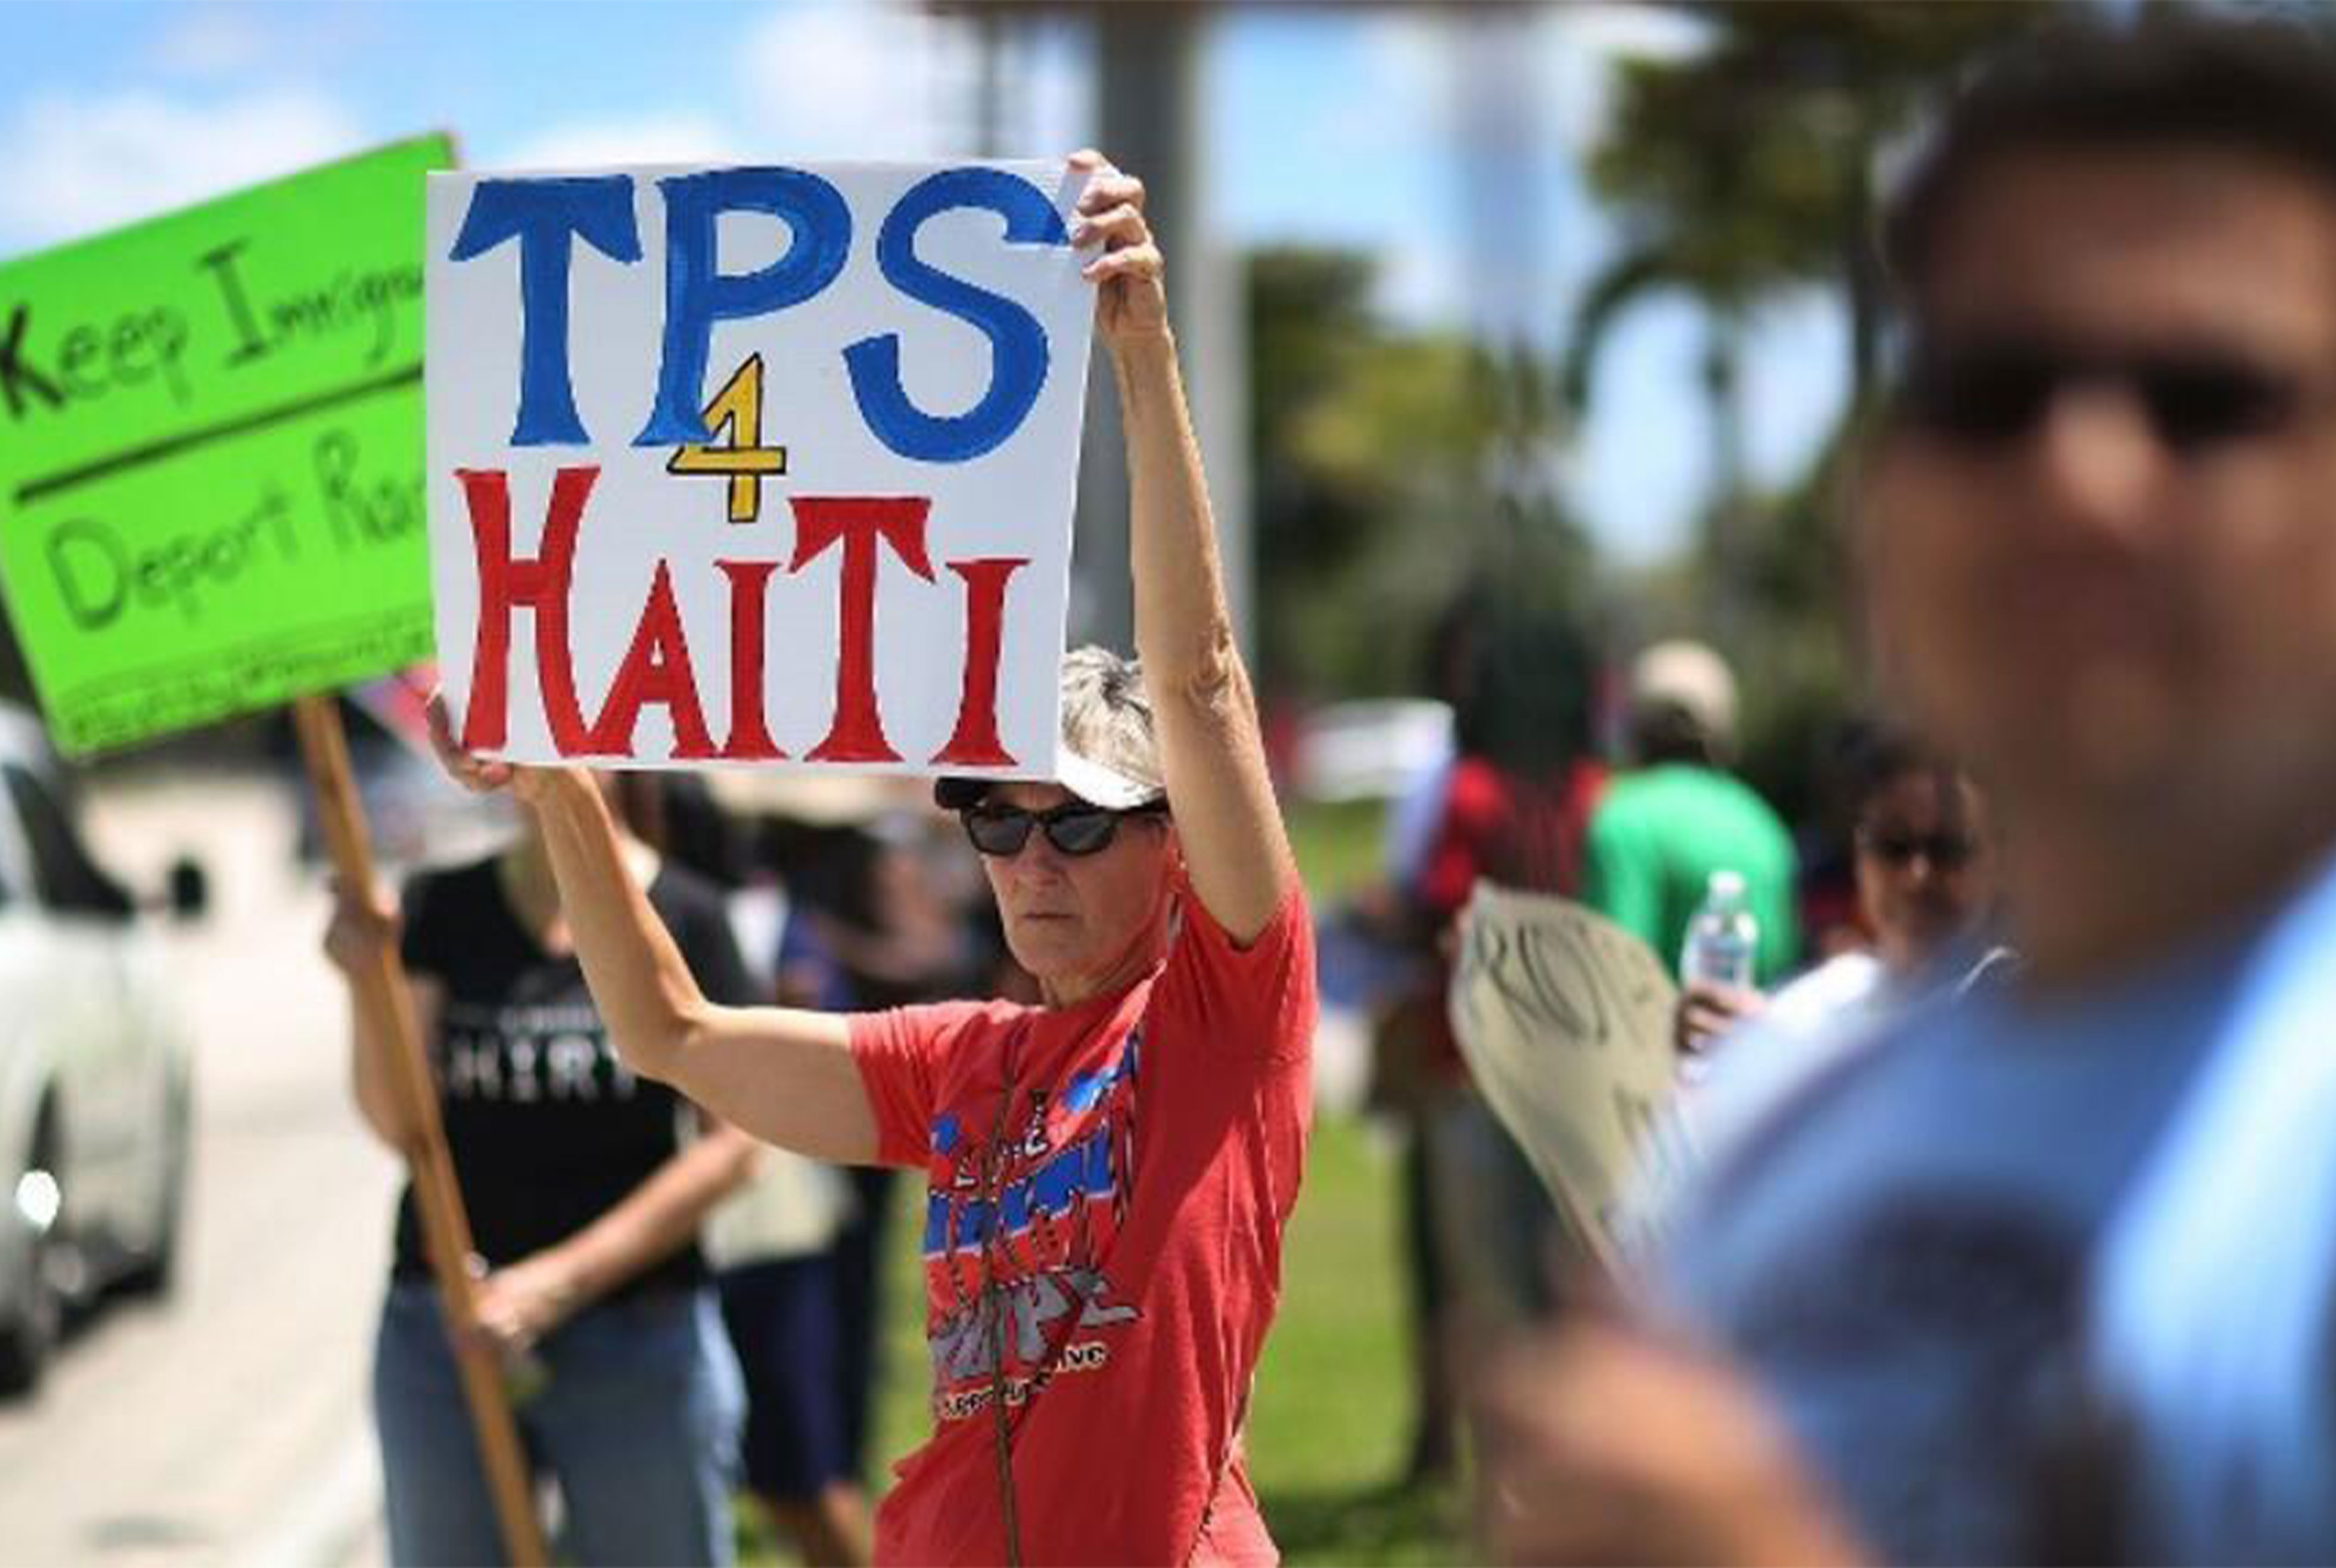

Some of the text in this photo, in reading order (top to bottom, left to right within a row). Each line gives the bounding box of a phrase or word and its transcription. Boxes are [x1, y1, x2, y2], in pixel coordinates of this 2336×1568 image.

[0, 301, 194, 420] Keep
[448, 167, 1070, 464] TPS
[667, 353, 787, 523] 4
[43, 517, 302, 632] Deport
[452, 466, 1032, 766] HAITI
